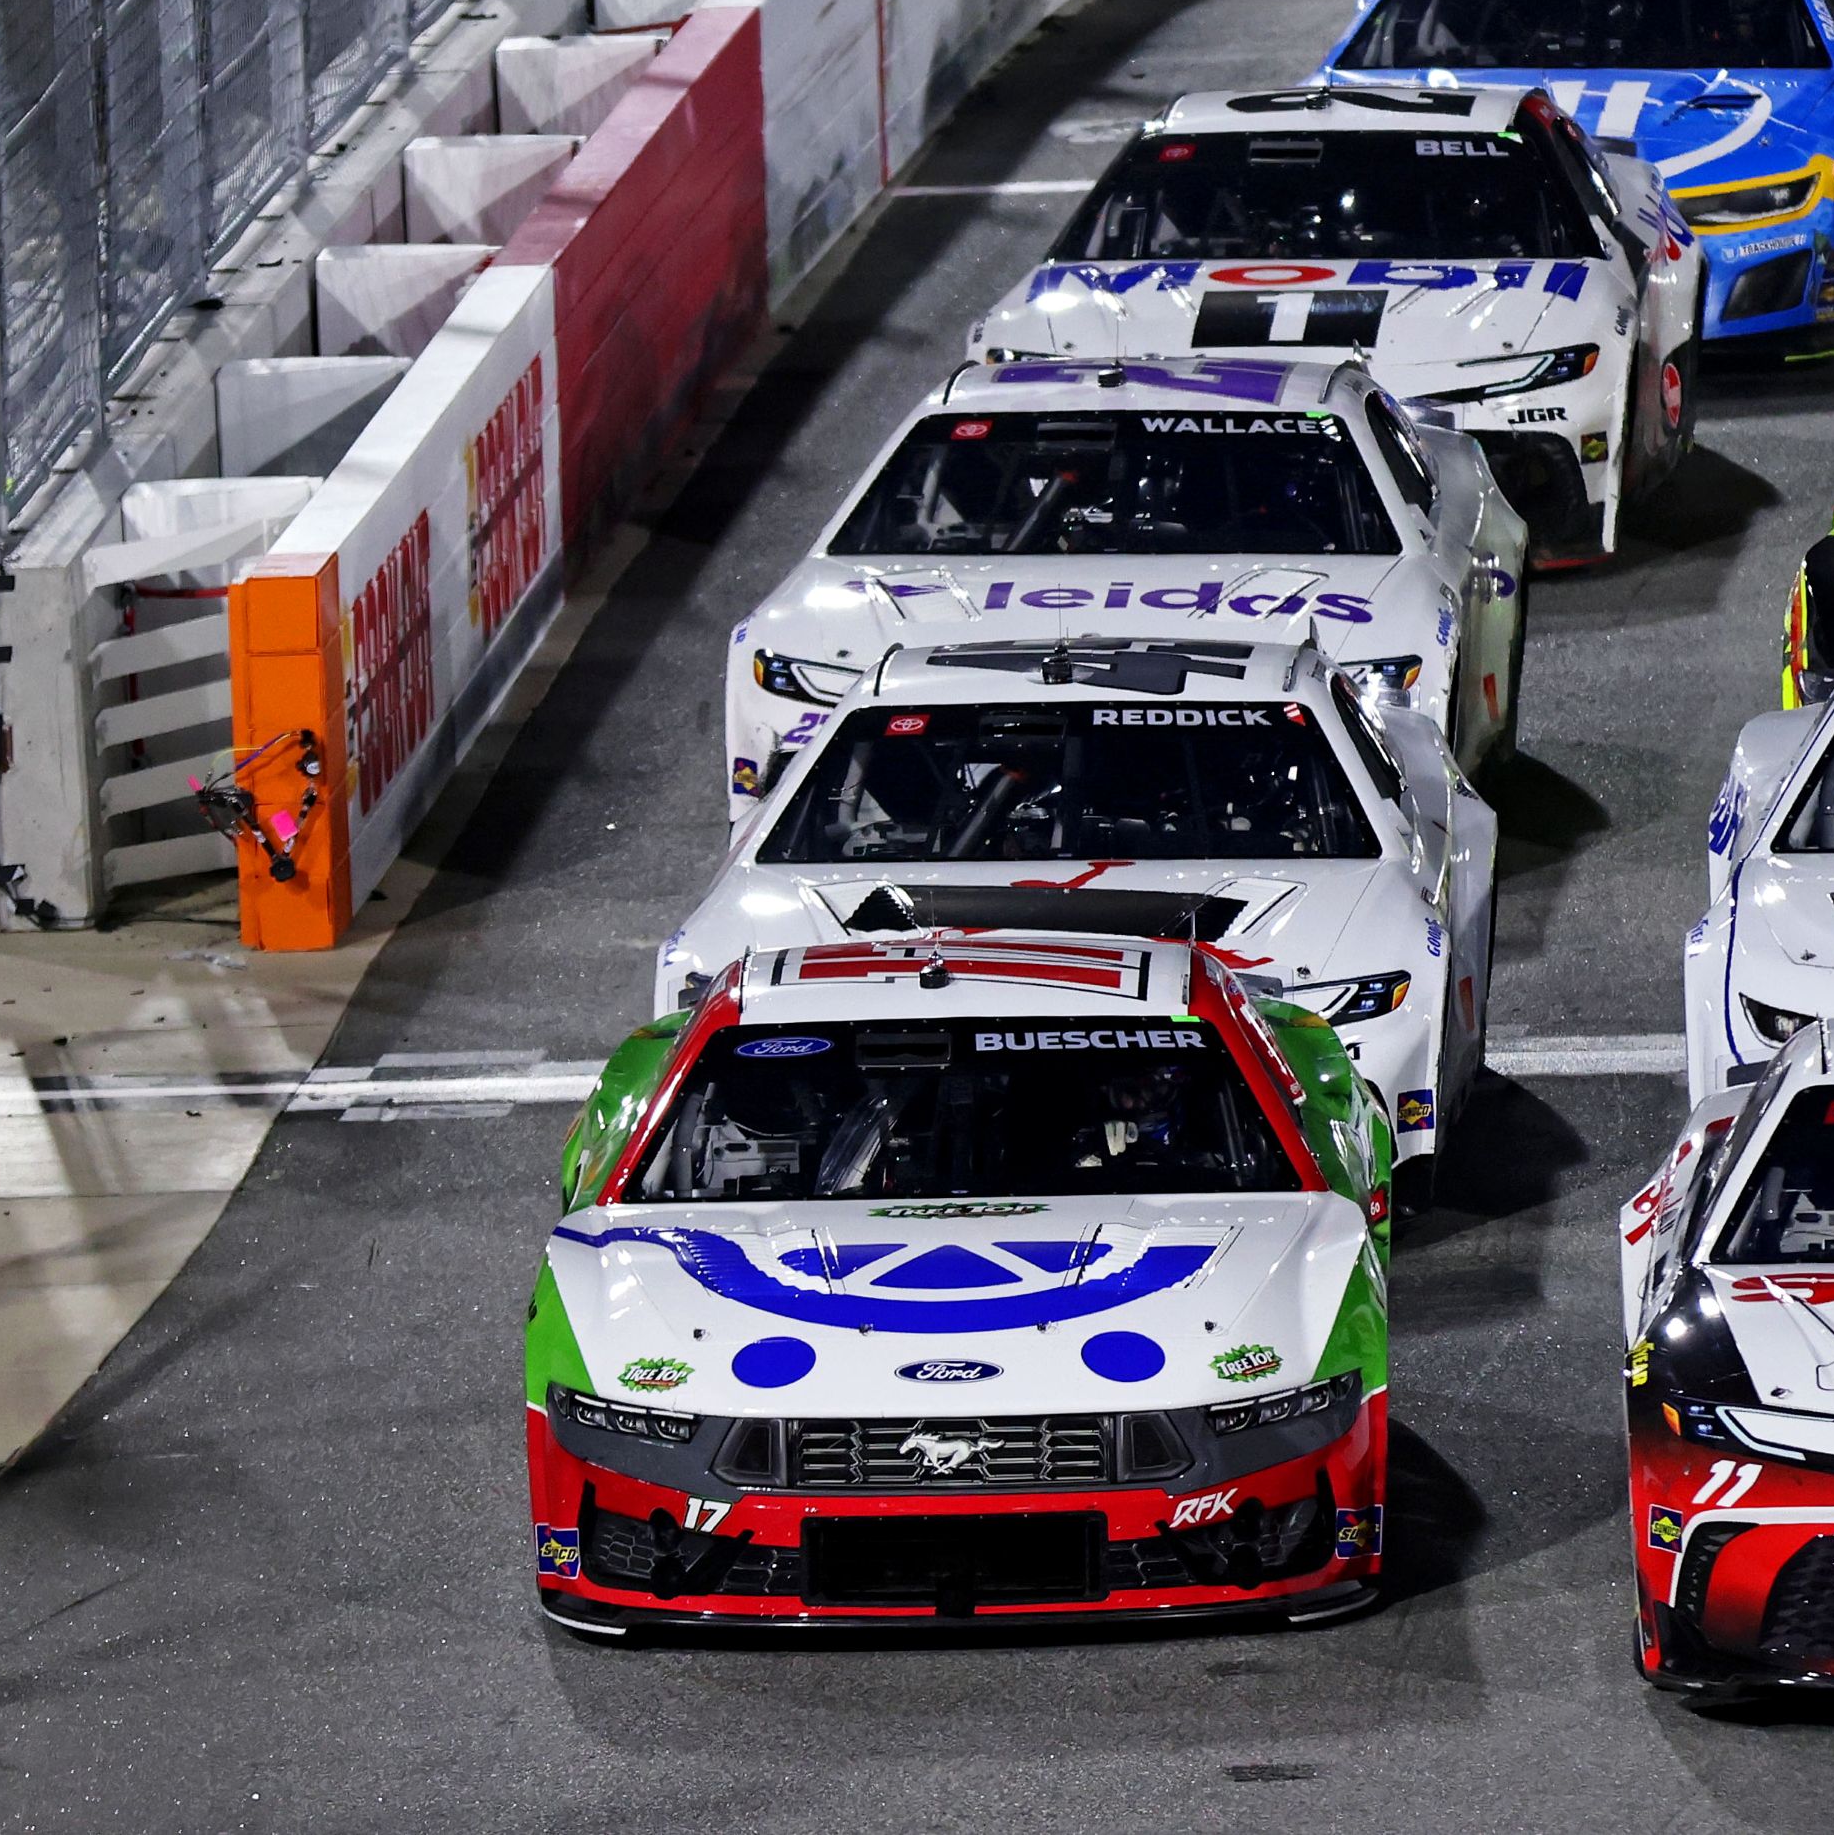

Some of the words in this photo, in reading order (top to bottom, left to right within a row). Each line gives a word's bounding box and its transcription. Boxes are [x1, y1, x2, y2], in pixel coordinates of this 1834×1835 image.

[1415, 138, 1511, 159] BELL
[1025, 259, 1590, 304] Mobil
[1255, 291, 1316, 344] 1
[1141, 417, 1320, 436] WALLACE
[1506, 406, 1569, 424] JGR
[983, 580, 1375, 625] leidos
[1092, 708, 1274, 728] REDDICK
[974, 1030, 1207, 1054] BUESCHER
[623, 1364, 658, 1382] TREE
[656, 1365, 689, 1383] TOP
[1217, 1360, 1250, 1377] TREE
[1247, 1349, 1276, 1368] TOP
[1690, 1458, 1764, 1508] 11
[682, 1496, 733, 1534] 17
[1169, 1487, 1239, 1528] RFK
[1651, 1520, 1682, 1537] SUNOCO
